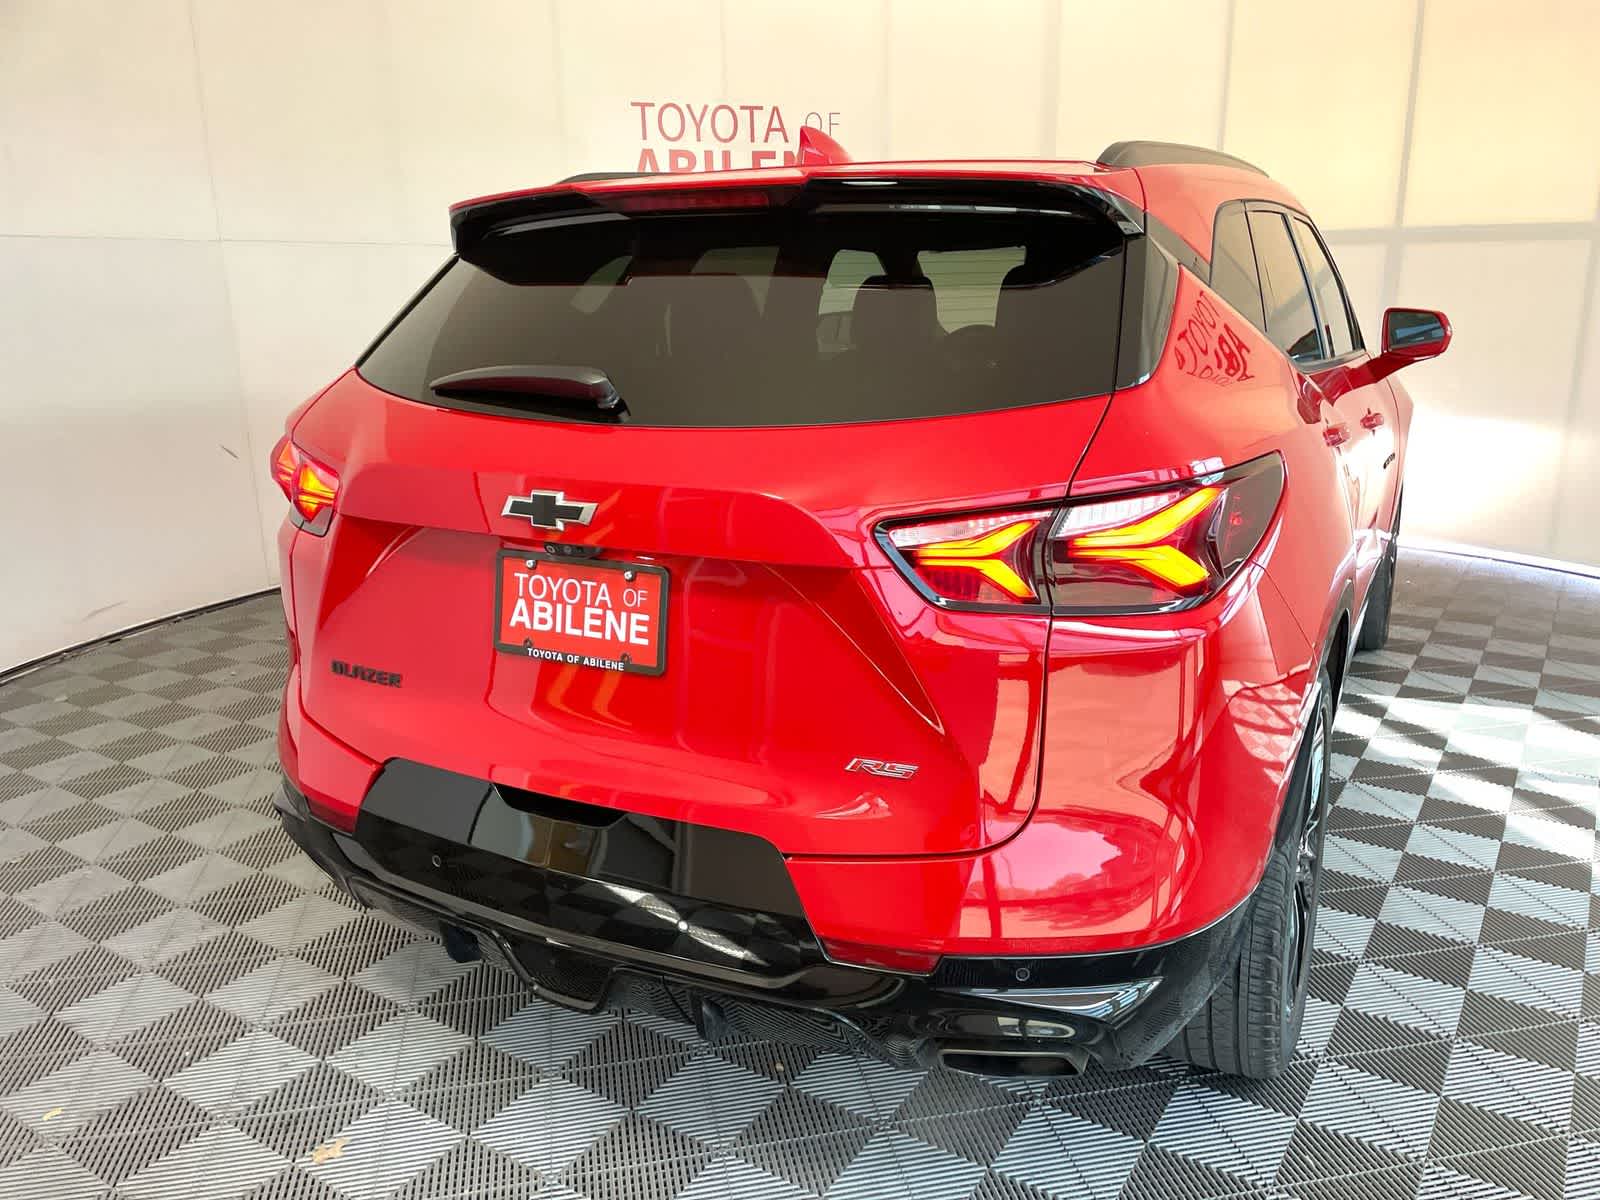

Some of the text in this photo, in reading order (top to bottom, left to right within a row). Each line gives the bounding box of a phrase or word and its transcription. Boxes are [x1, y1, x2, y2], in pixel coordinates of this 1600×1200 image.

[630, 101, 789, 143] TOYOTA
[513, 572, 648, 609] TOYOTA OF
[509, 597, 650, 646] ABILENE
[331, 659, 403, 688] BLAZER
[527, 647, 625, 672] TOYOTA OF ABILENE
[844, 757, 919, 779] RS
